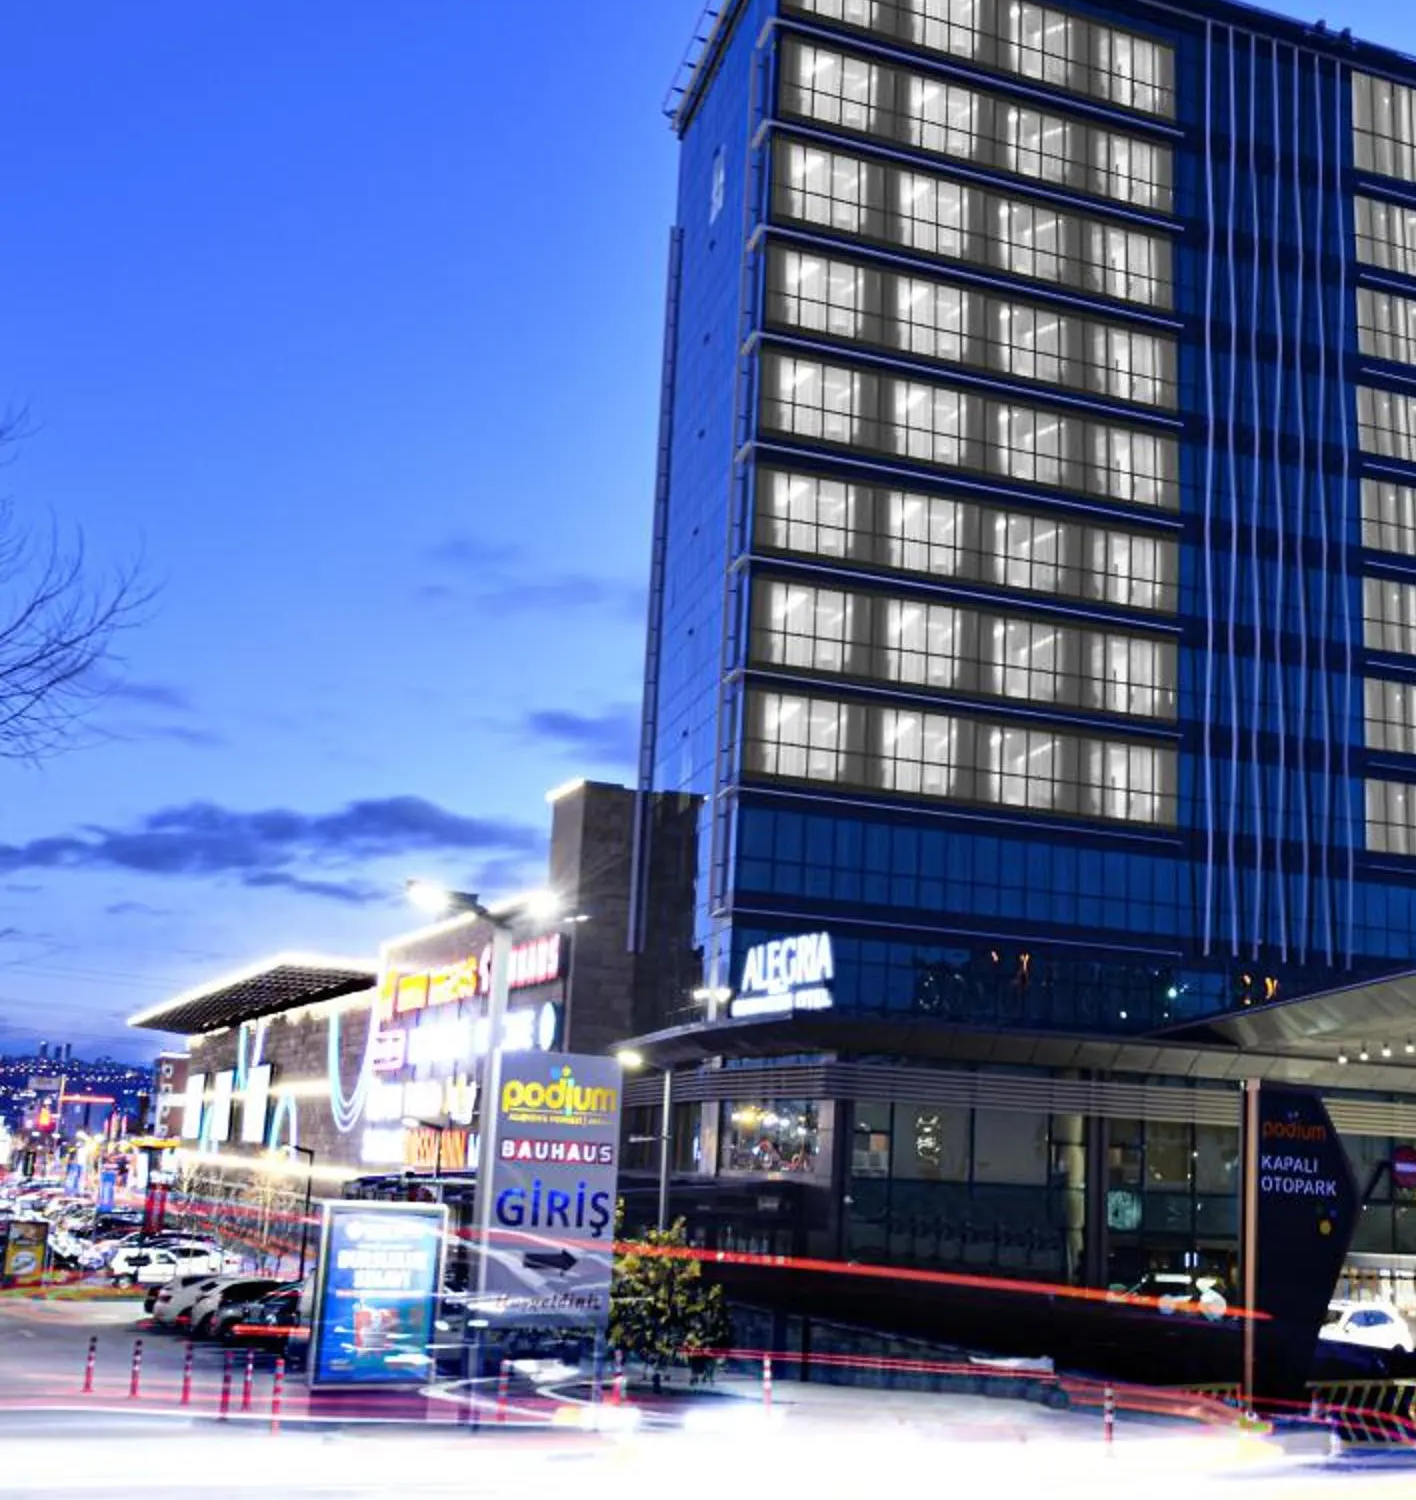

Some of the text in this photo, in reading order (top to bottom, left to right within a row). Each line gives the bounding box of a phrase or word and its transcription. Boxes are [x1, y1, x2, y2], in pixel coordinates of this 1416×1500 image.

[741, 931, 834, 993] ALEGRIA
[502, 1066, 617, 1116] podium
[1263, 1113, 1326, 1141] podium
[501, 1139, 613, 1163] BAUHAUS
[1260, 1155, 1319, 1173] KAPALI
[1261, 1175, 1336, 1197] OTOPARK
[495, 1180, 610, 1238] GİRİŞ
